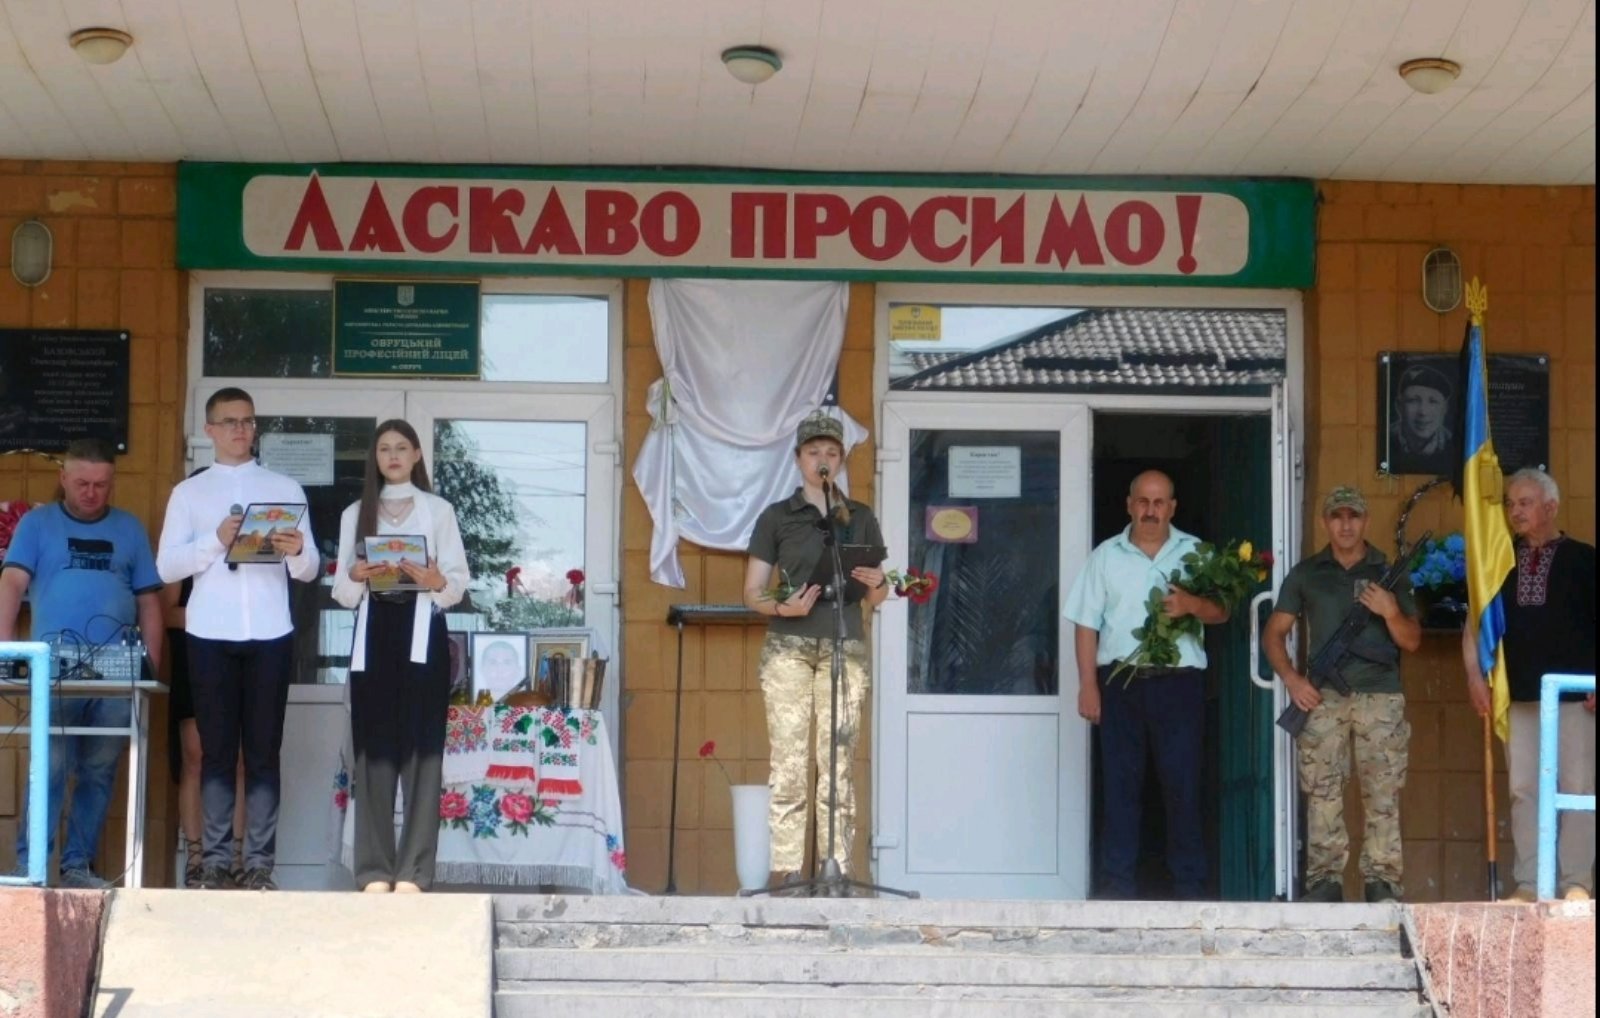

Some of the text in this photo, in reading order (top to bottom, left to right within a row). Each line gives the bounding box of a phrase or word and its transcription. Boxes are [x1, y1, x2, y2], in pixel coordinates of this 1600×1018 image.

[284, 172, 1203, 275] ЛАСКАВО ПРОСИМО!
[370, 337, 443, 349] ОВРУЦЬКИЙ
[344, 348, 470, 361] ПРОФЕСІЙНИЙ ЛІЦЕЙ
